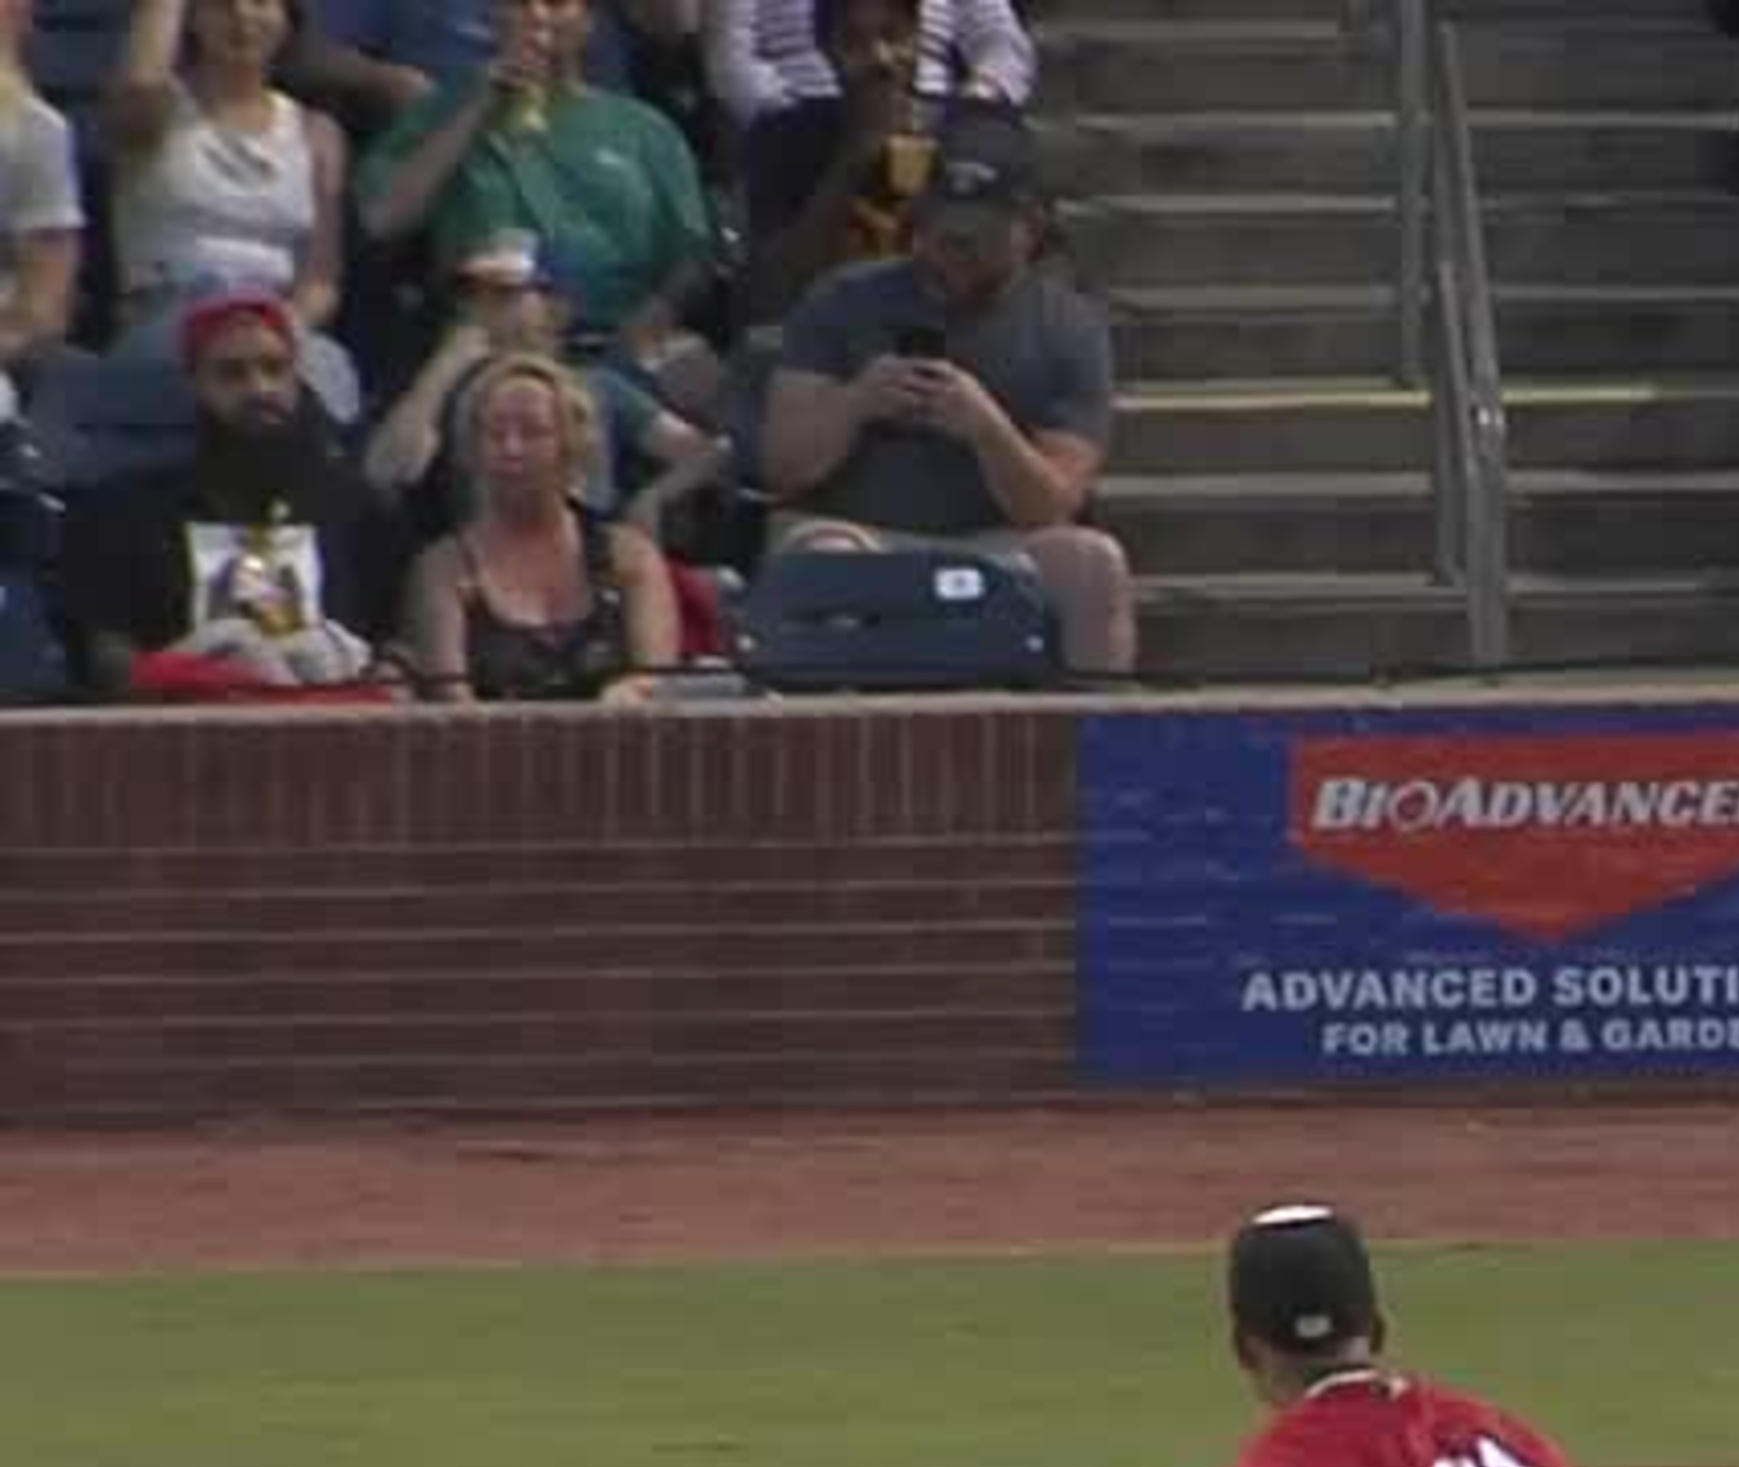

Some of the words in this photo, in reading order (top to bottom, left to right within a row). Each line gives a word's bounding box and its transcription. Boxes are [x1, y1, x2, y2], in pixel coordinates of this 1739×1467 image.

[1242, 970, 1537, 1012] ADVANCED
[1322, 1023, 1408, 1056] FOR
[1422, 1021, 1547, 1054] LAWN
[1560, 1019, 1592, 1052] &
